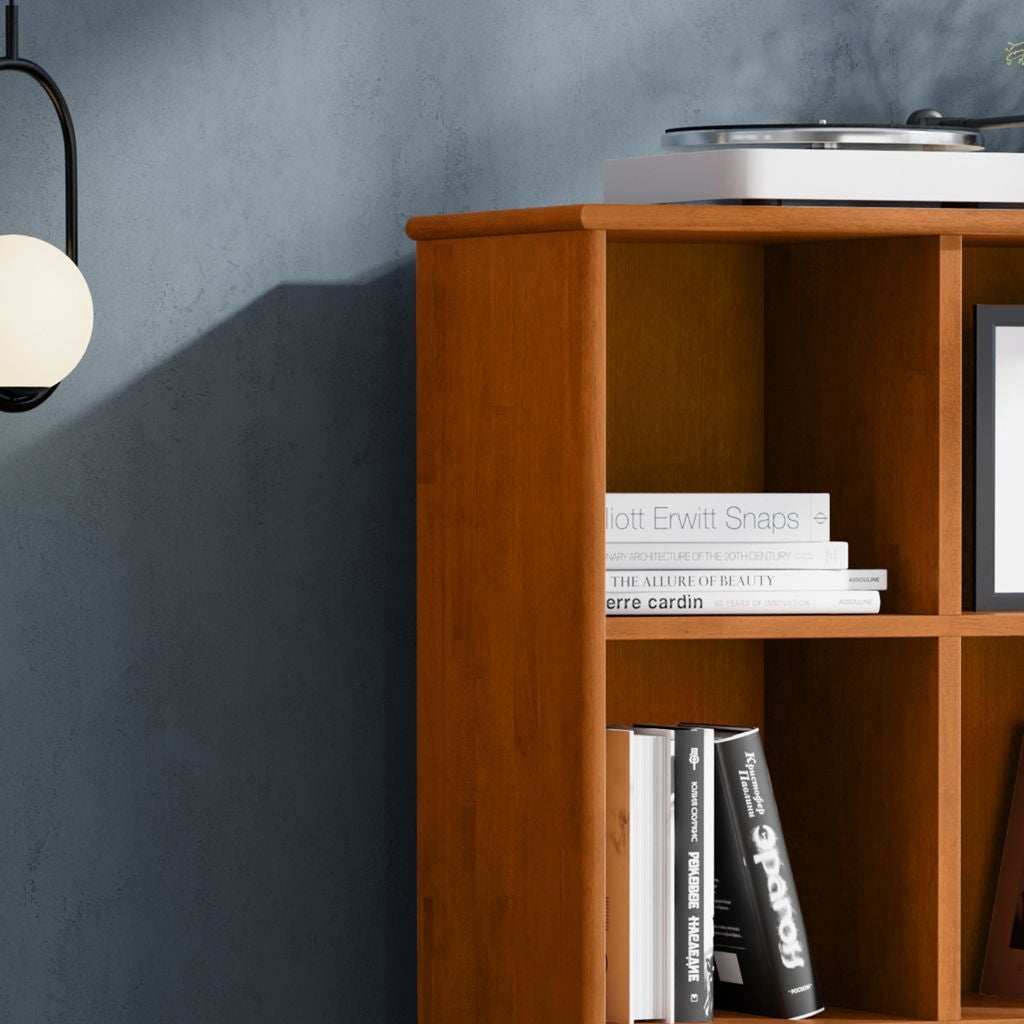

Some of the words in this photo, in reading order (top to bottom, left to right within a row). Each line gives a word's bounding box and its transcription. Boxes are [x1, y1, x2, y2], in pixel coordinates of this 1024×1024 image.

[653, 506, 717, 530] Erwitt
[725, 505, 800, 535] Snaps
[629, 552, 691, 561] ARCHITECTURE
[692, 552, 704, 561] OF
[705, 552, 722, 561] THE
[723, 552, 748, 561] 20TH
[749, 551, 792, 561] CENTURY
[610, 575, 640, 588] THE
[642, 575, 696, 588] ALLURE
[698, 575, 717, 588] OF
[720, 575, 775, 587] BEAUTY
[606, 597, 641, 610] erre
[648, 594, 703, 610] cardin
[738, 769, 756, 818] Паолини
[745, 751, 766, 815] Кристофер
